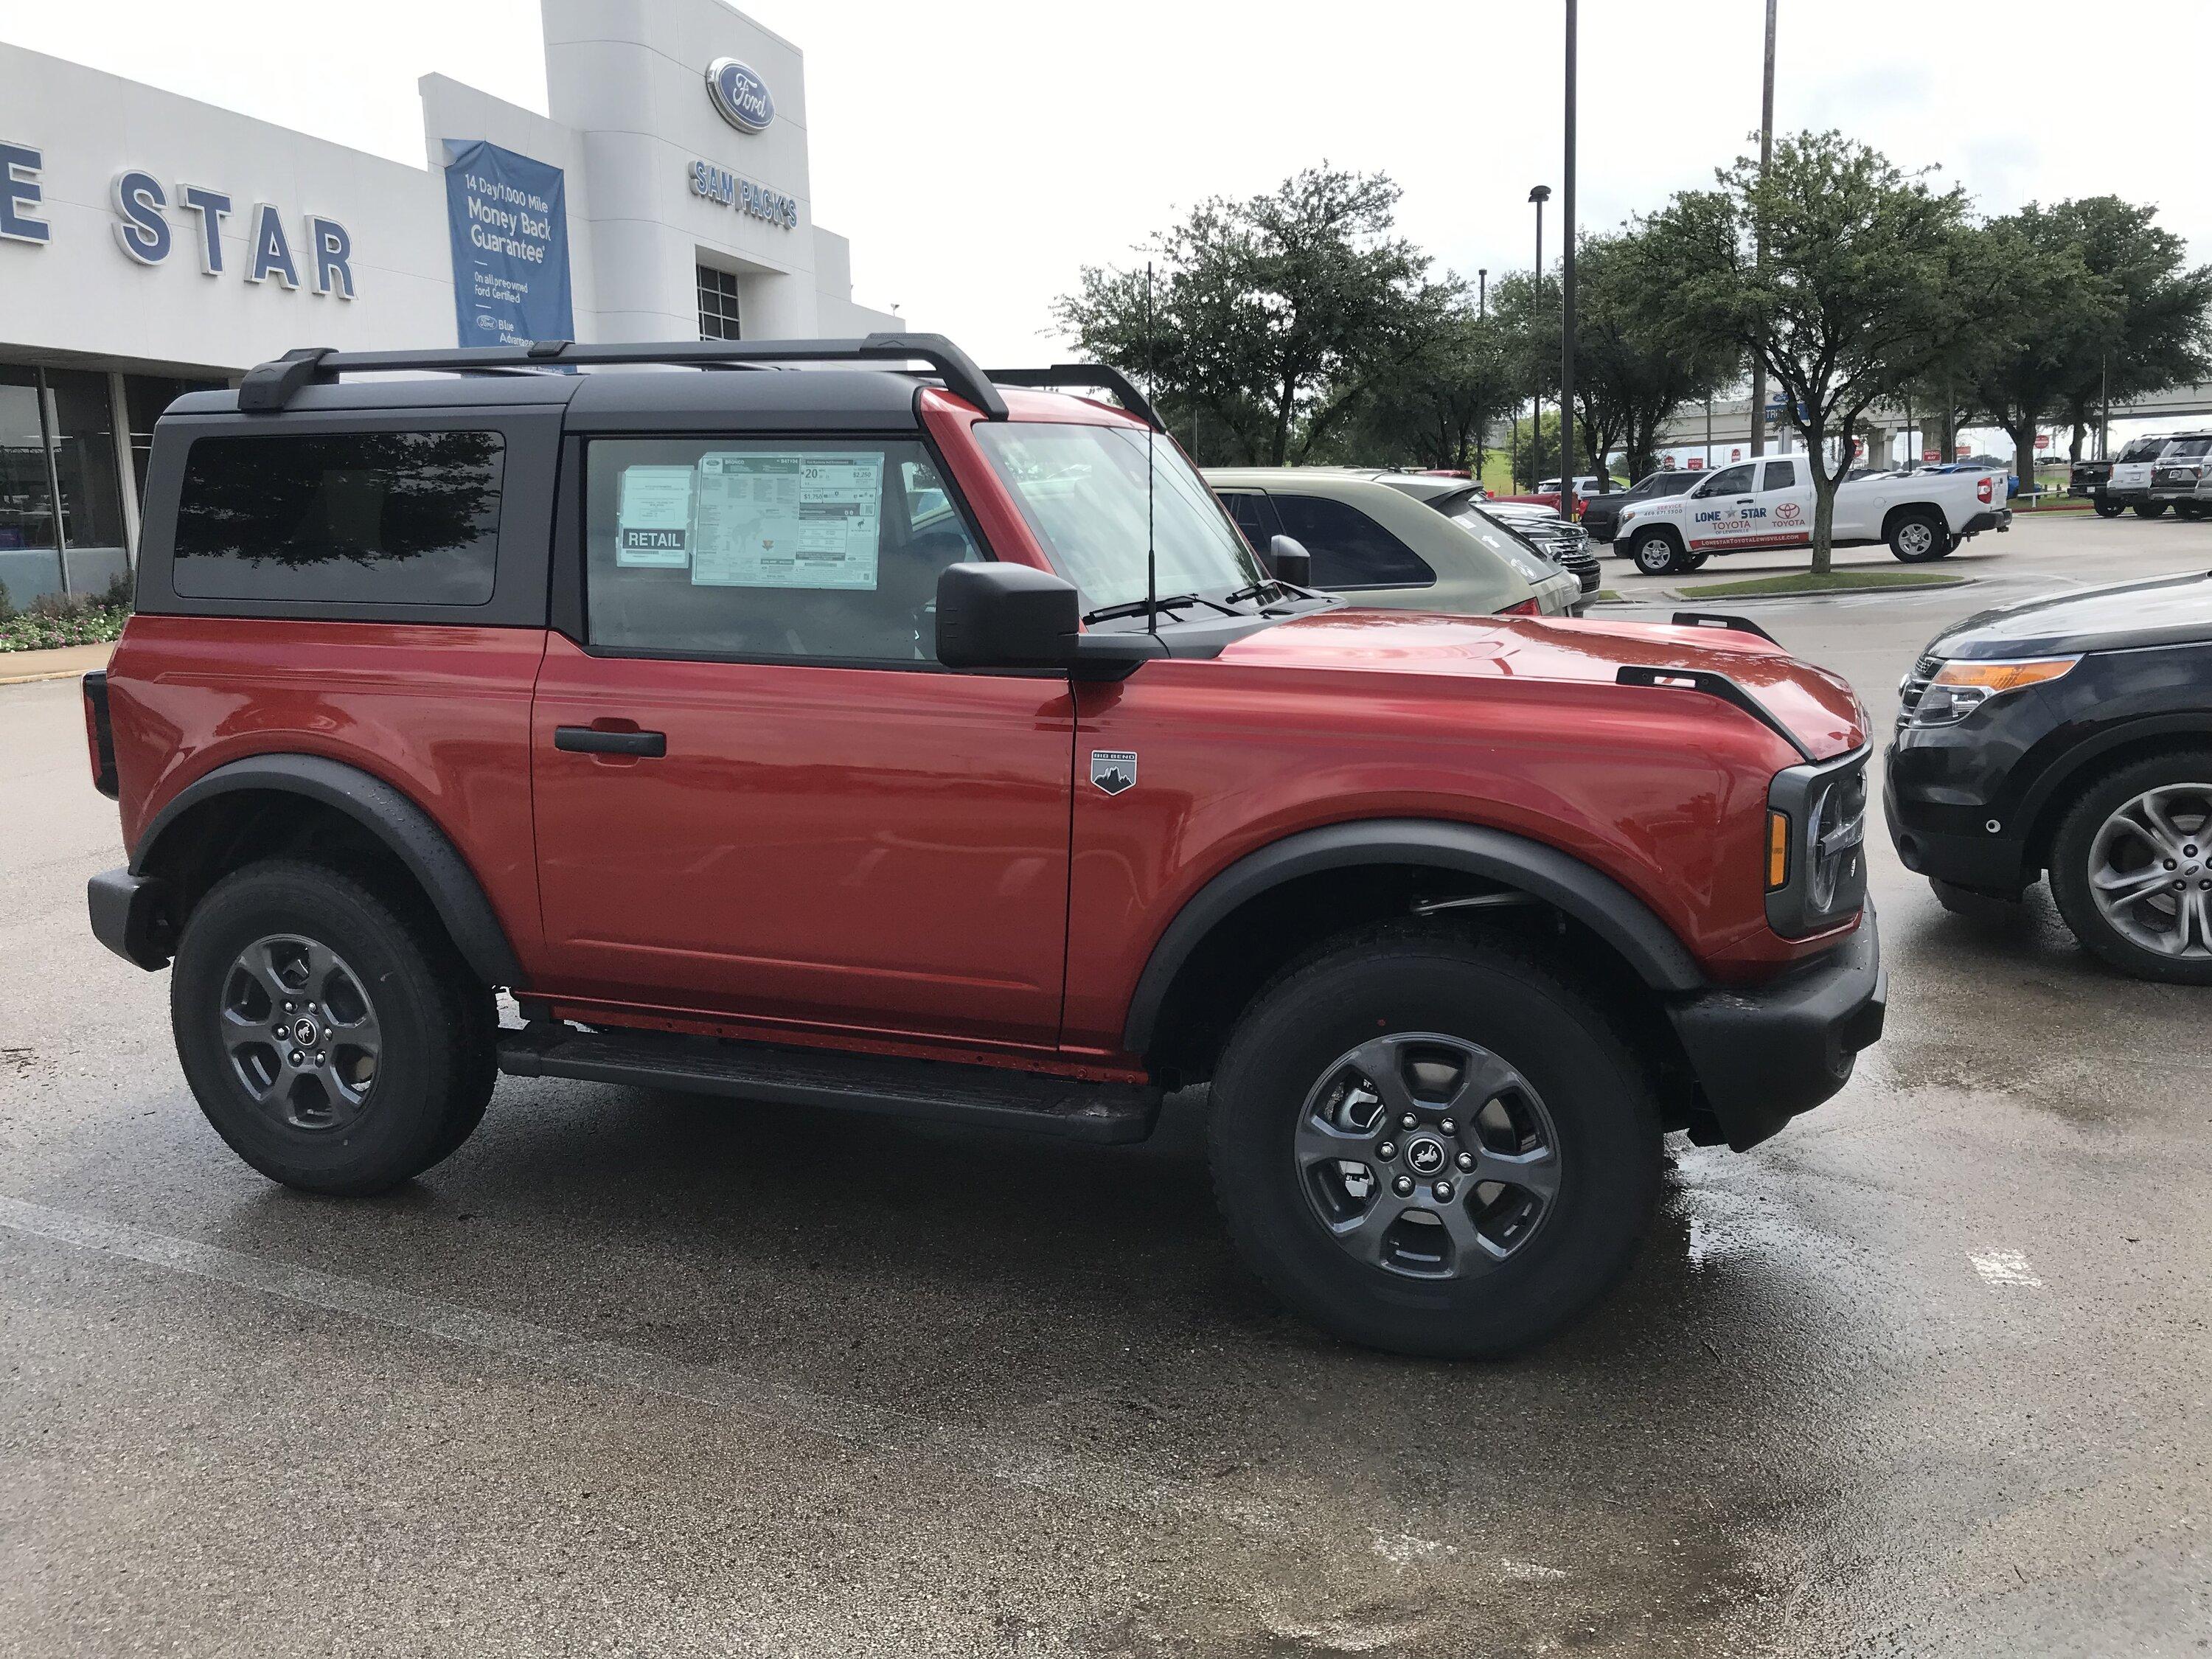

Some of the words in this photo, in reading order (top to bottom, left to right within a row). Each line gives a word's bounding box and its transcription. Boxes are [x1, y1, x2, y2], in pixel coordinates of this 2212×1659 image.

[733, 72, 767, 118] Ford
[465, 173, 478, 191] 14
[479, 176, 526, 207] Day/1,000
[528, 193, 549, 214] Mile
[690, 159, 734, 206] SAM
[737, 178, 798, 230] PACK'S
[467, 195, 518, 237] Money
[521, 212, 552, 242] Back
[111, 169, 359, 301] STAR
[474, 271, 484, 283] On
[484, 274, 495, 285] all
[475, 285, 491, 297] Ford
[492, 288, 521, 304] Certified
[498, 319, 515, 332] Blue
[499, 332, 535, 347] Advantage
[805, 468, 818, 479] 20
[1695, 510, 1722, 523] LONE
[1740, 507, 1767, 519] STAR
[1711, 520, 1751, 530] TOYOTA
[1772, 519, 1806, 528] TOYOTA
[628, 532, 681, 547] RETAIL
